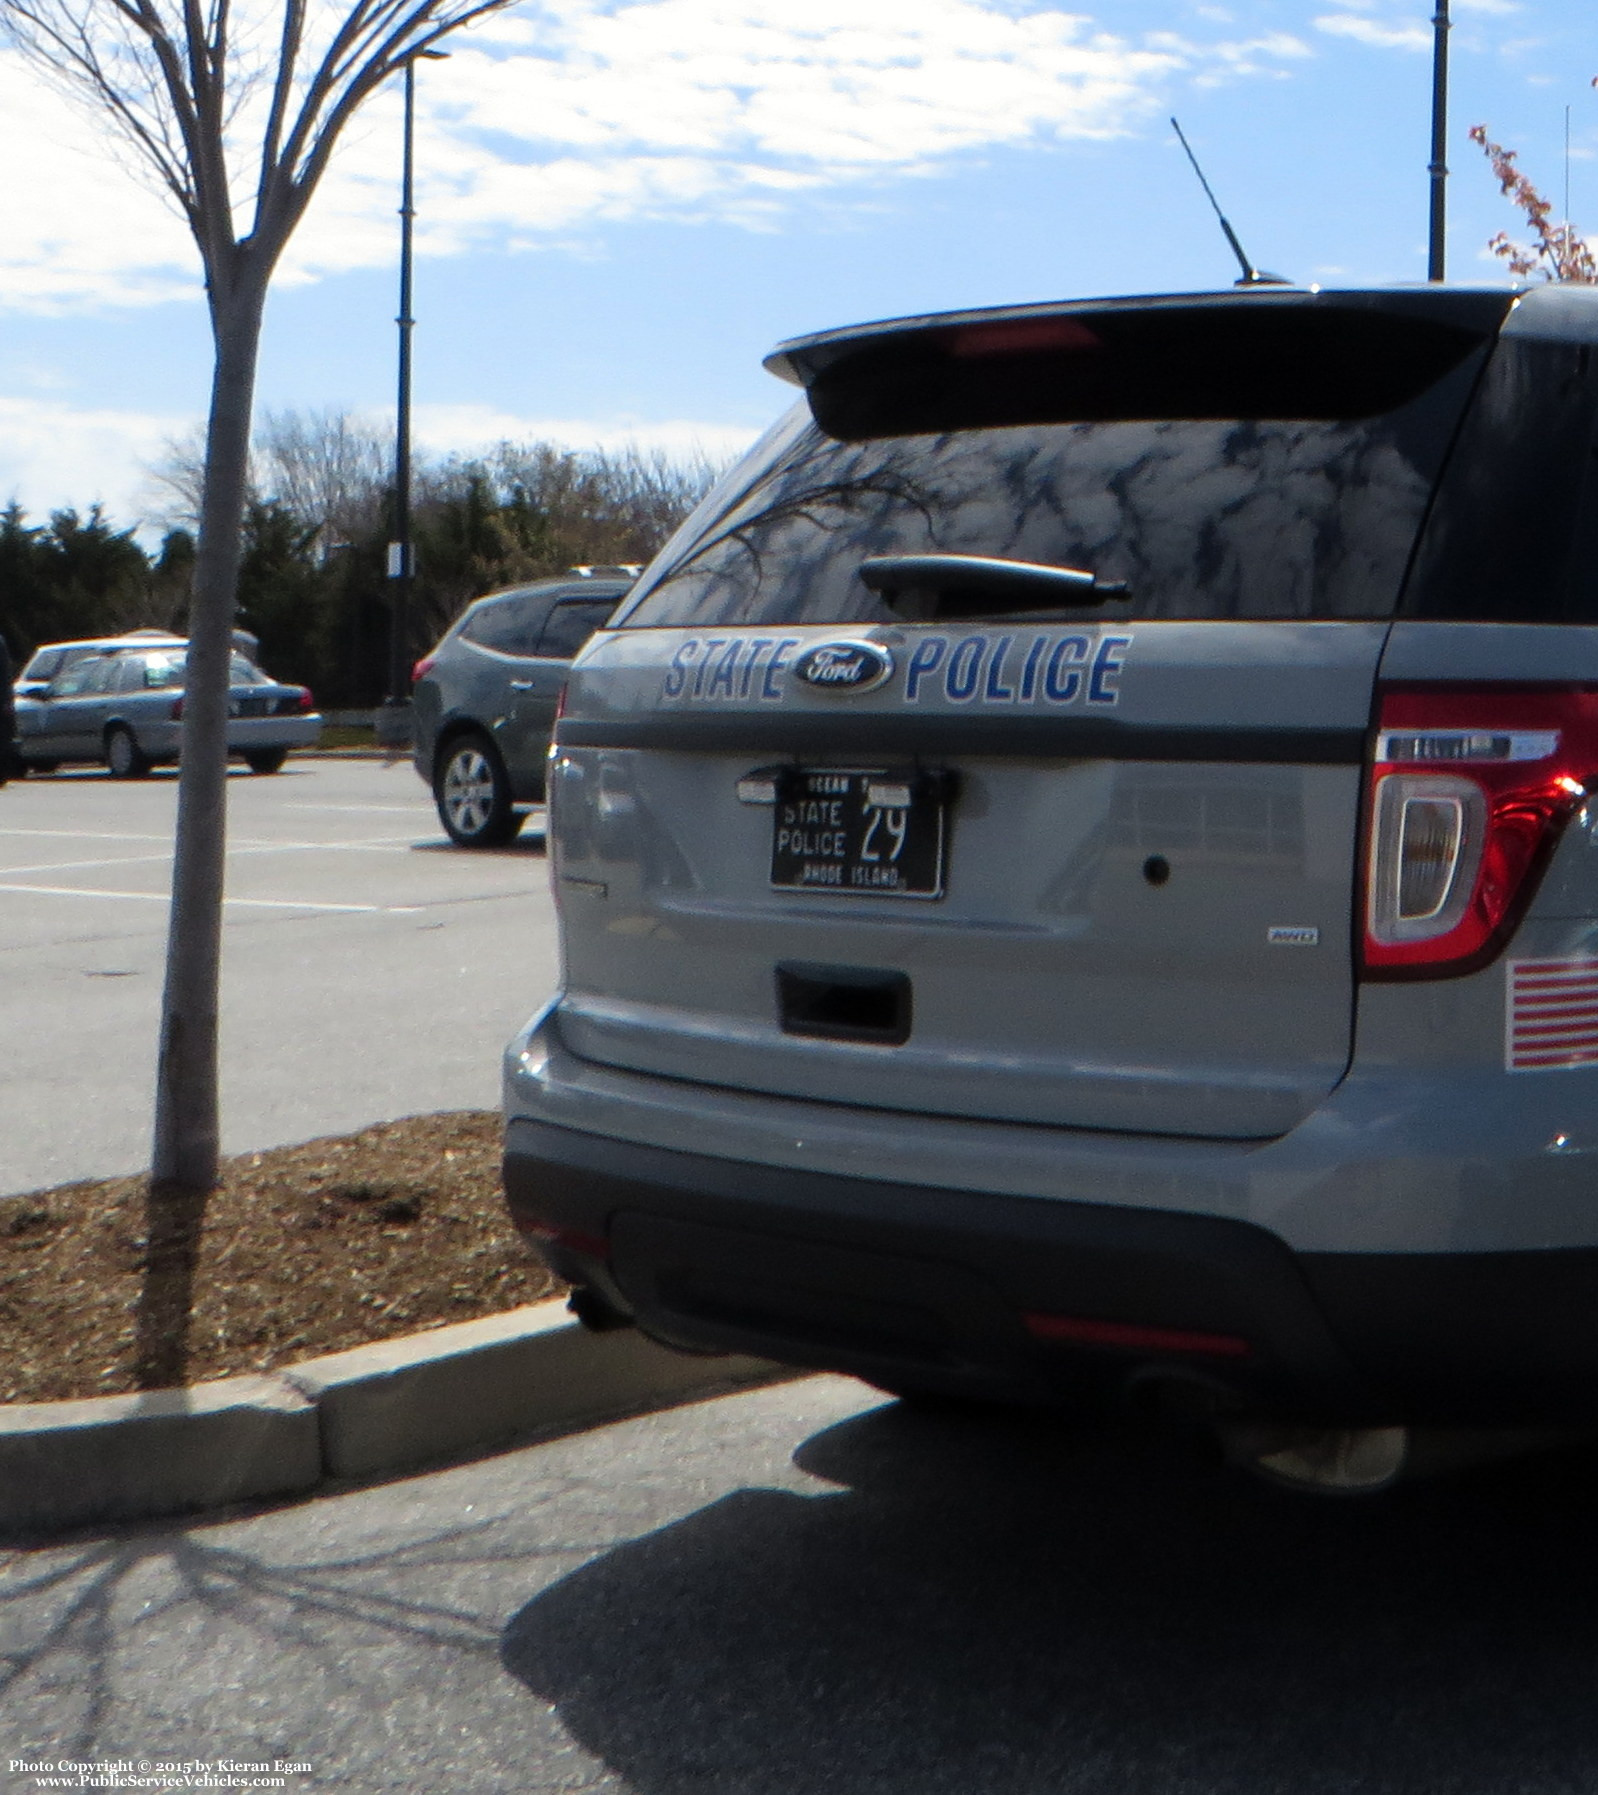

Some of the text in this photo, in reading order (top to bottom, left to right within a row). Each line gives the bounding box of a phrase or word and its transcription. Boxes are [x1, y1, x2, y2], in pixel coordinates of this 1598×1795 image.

[662, 634, 1134, 704] STATE POLICE
[807, 649, 865, 681] Ford
[784, 801, 844, 827] STATE
[777, 828, 847, 857] POLICE
[860, 803, 907, 862] 29
[803, 863, 899, 887] RHODE ISLAND
